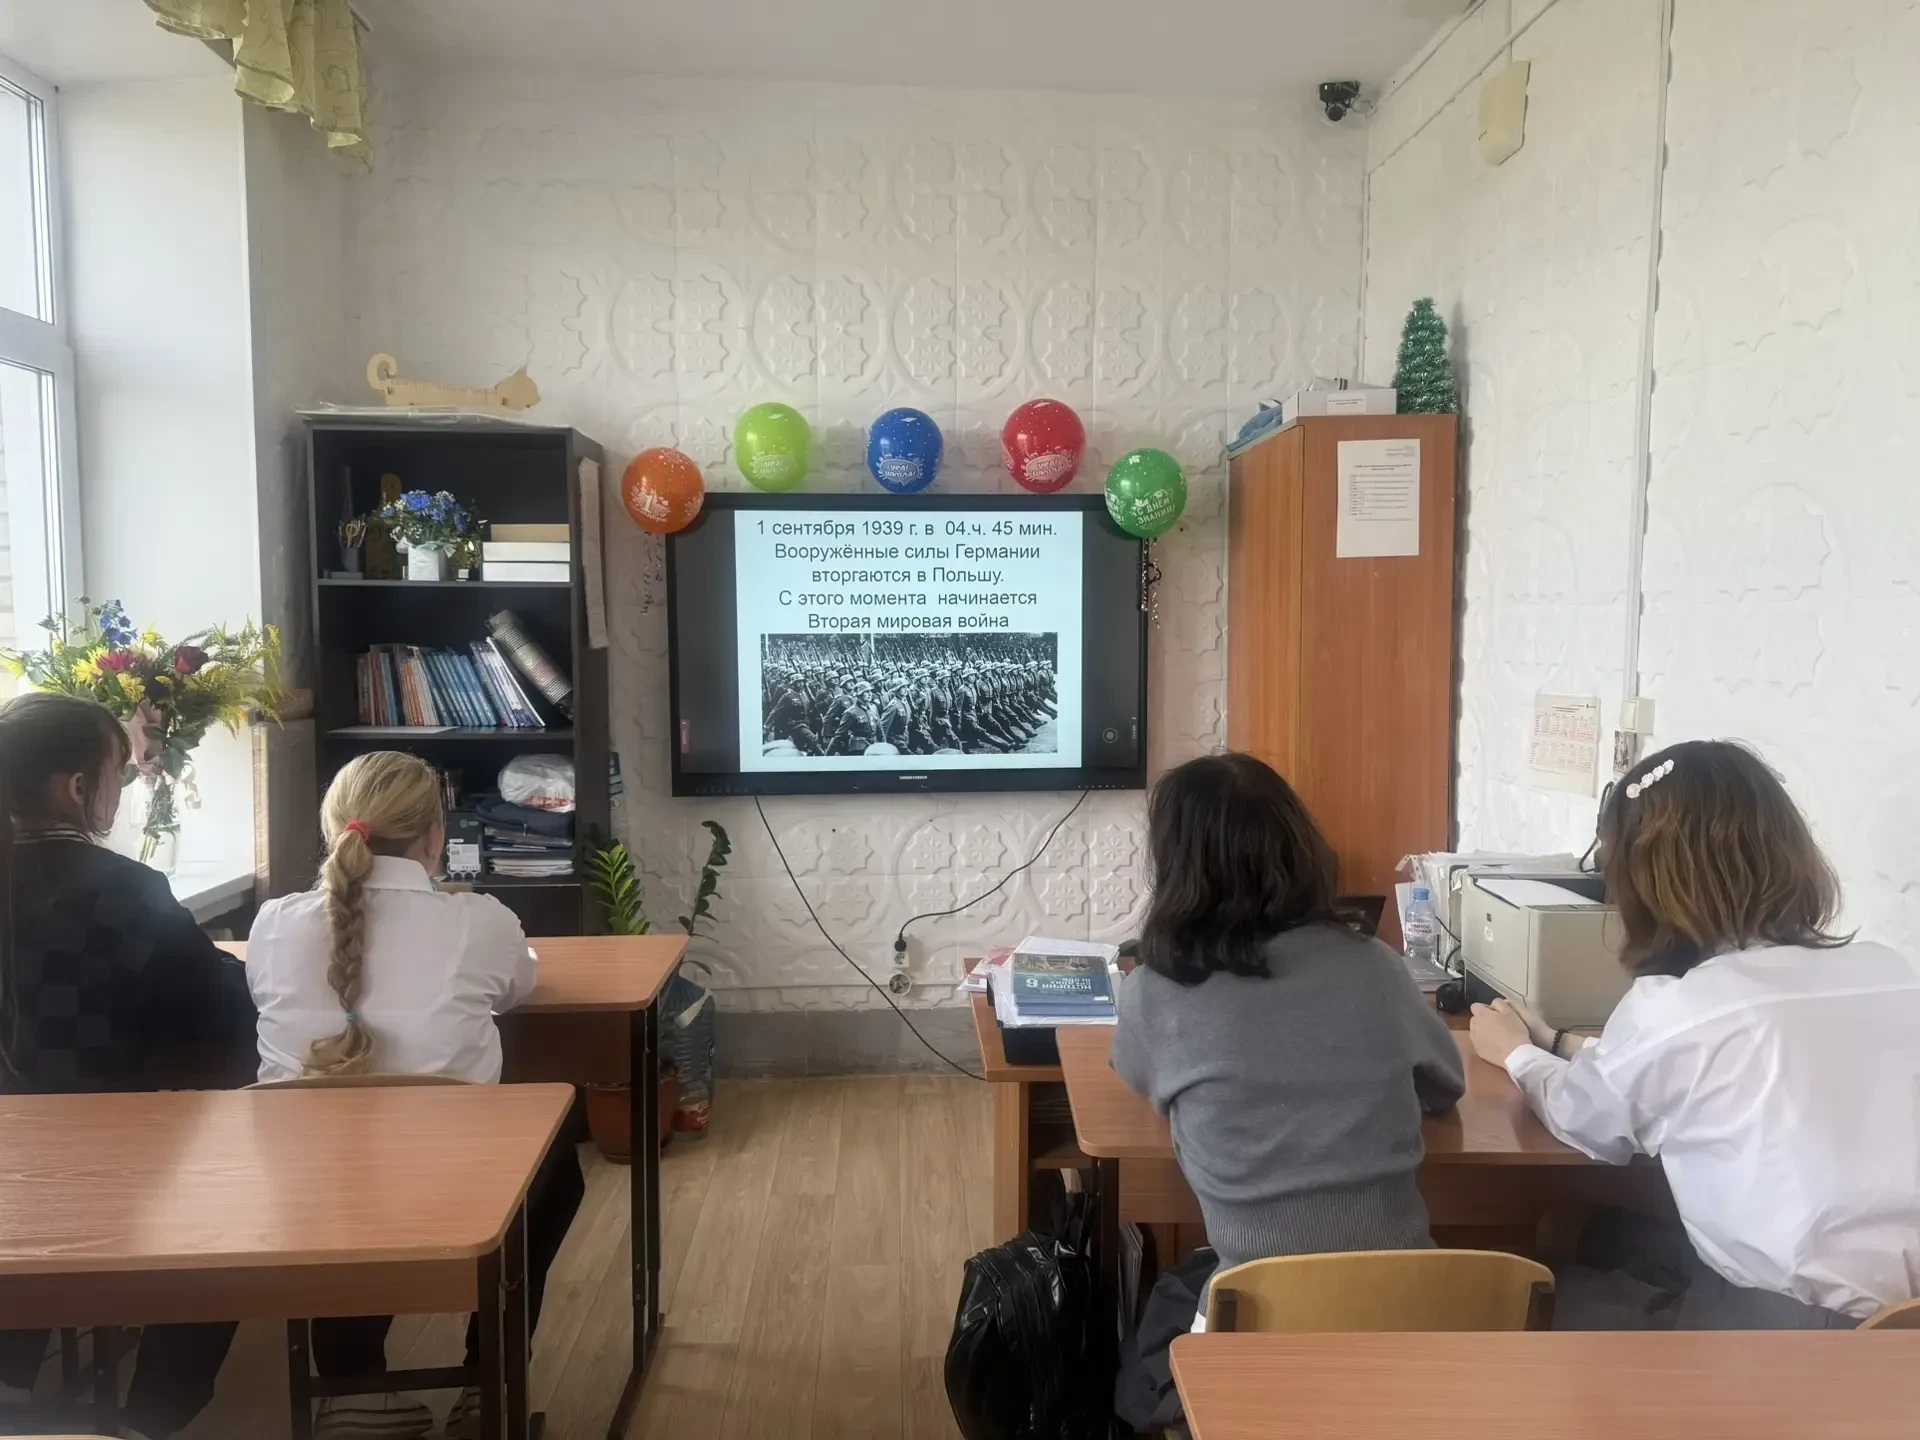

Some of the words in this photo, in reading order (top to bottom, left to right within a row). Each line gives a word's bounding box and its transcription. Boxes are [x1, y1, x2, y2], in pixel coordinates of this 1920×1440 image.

[1136, 507, 1144, 516] С
[757, 519, 764, 535] 1
[772, 519, 855, 539] сентября
[862, 520, 904, 536] 1939
[909, 523, 918, 536] г.
[924, 523, 935, 536] в
[945, 520, 986, 536] 04.ч.
[991, 520, 1014, 536] 45
[1019, 523, 1057, 536] мин.
[775, 543, 899, 562] Вооружённые
[904, 546, 949, 559] силы
[955, 543, 1040, 562] Германии
[812, 569, 911, 586] вторгаются
[917, 570, 927, 582] в
[933, 566, 1004, 586] Польшу.
[778, 589, 792, 606] С
[798, 593, 844, 606] этого
[850, 593, 927, 606] момента
[938, 592, 1037, 605] начинается
[808, 613, 871, 632] Вторая
[877, 616, 952, 631] мировая
[958, 612, 1009, 628] война
